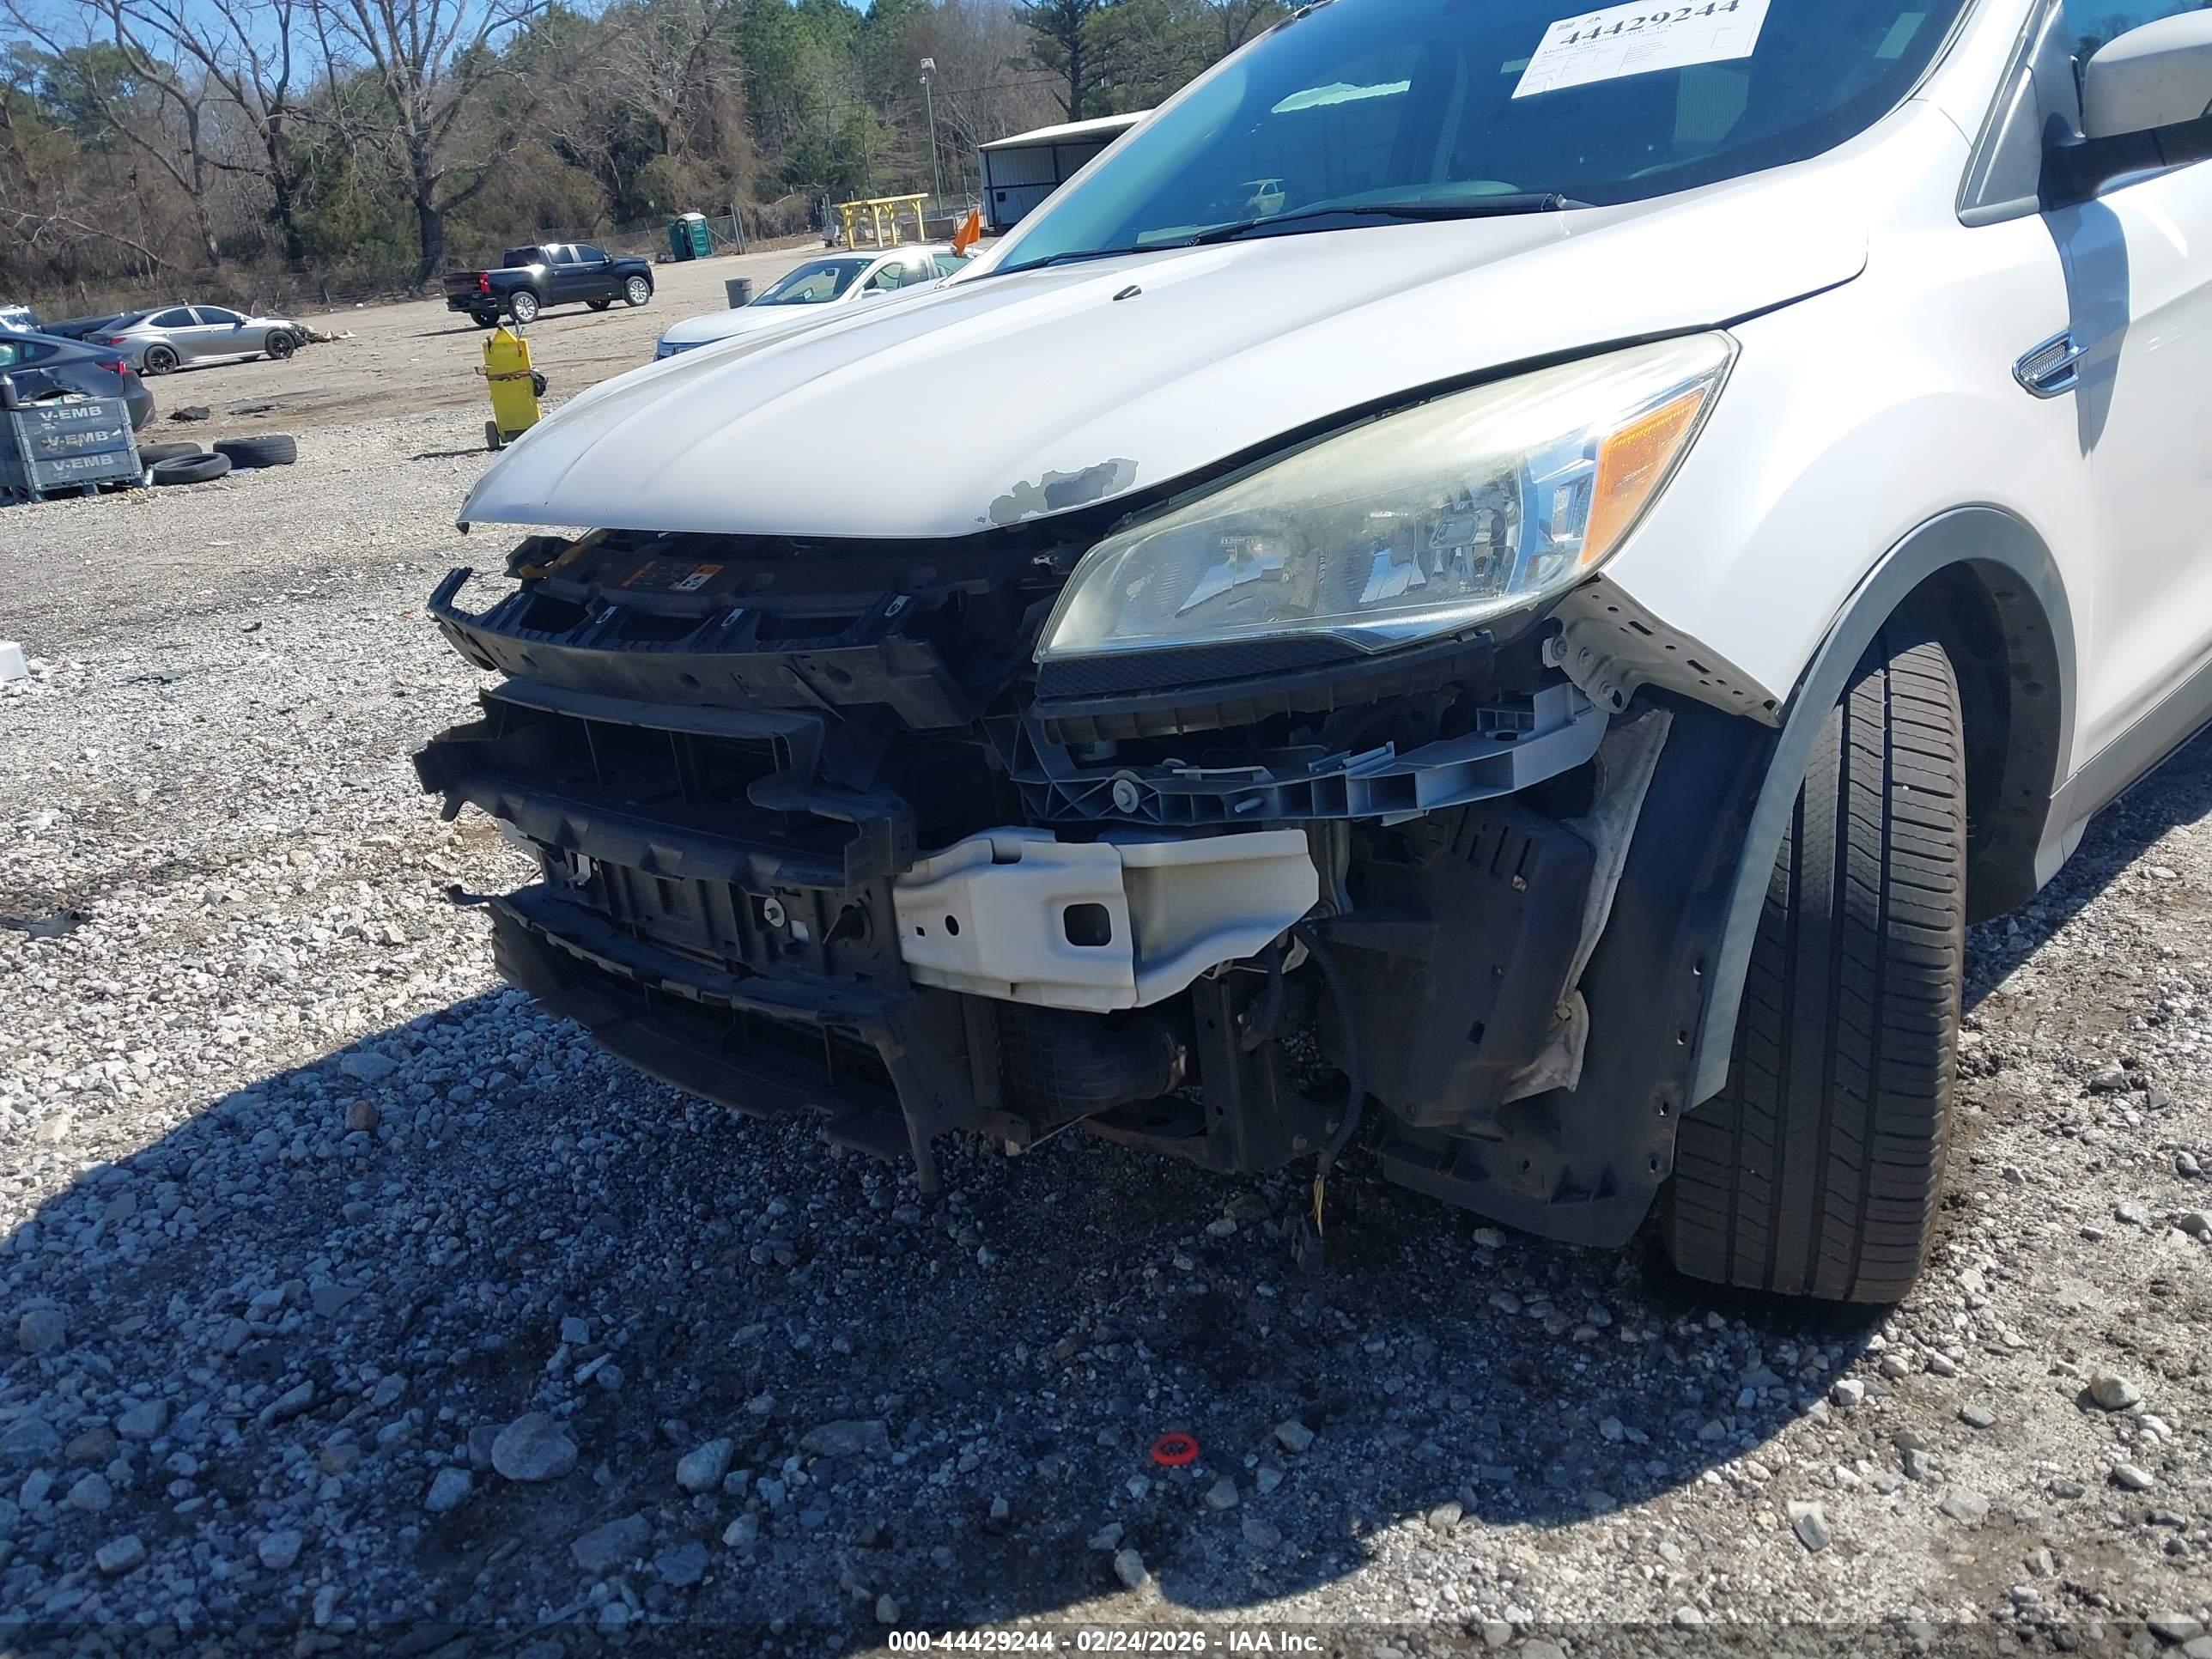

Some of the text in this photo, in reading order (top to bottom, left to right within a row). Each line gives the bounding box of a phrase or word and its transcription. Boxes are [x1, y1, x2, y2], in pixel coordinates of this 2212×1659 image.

[1559, 0, 1740, 45] 44429244
[39, 406, 102, 421] V-EMB
[46, 431, 109, 447] V-EMB
[52, 455, 113, 471] V-EMB
